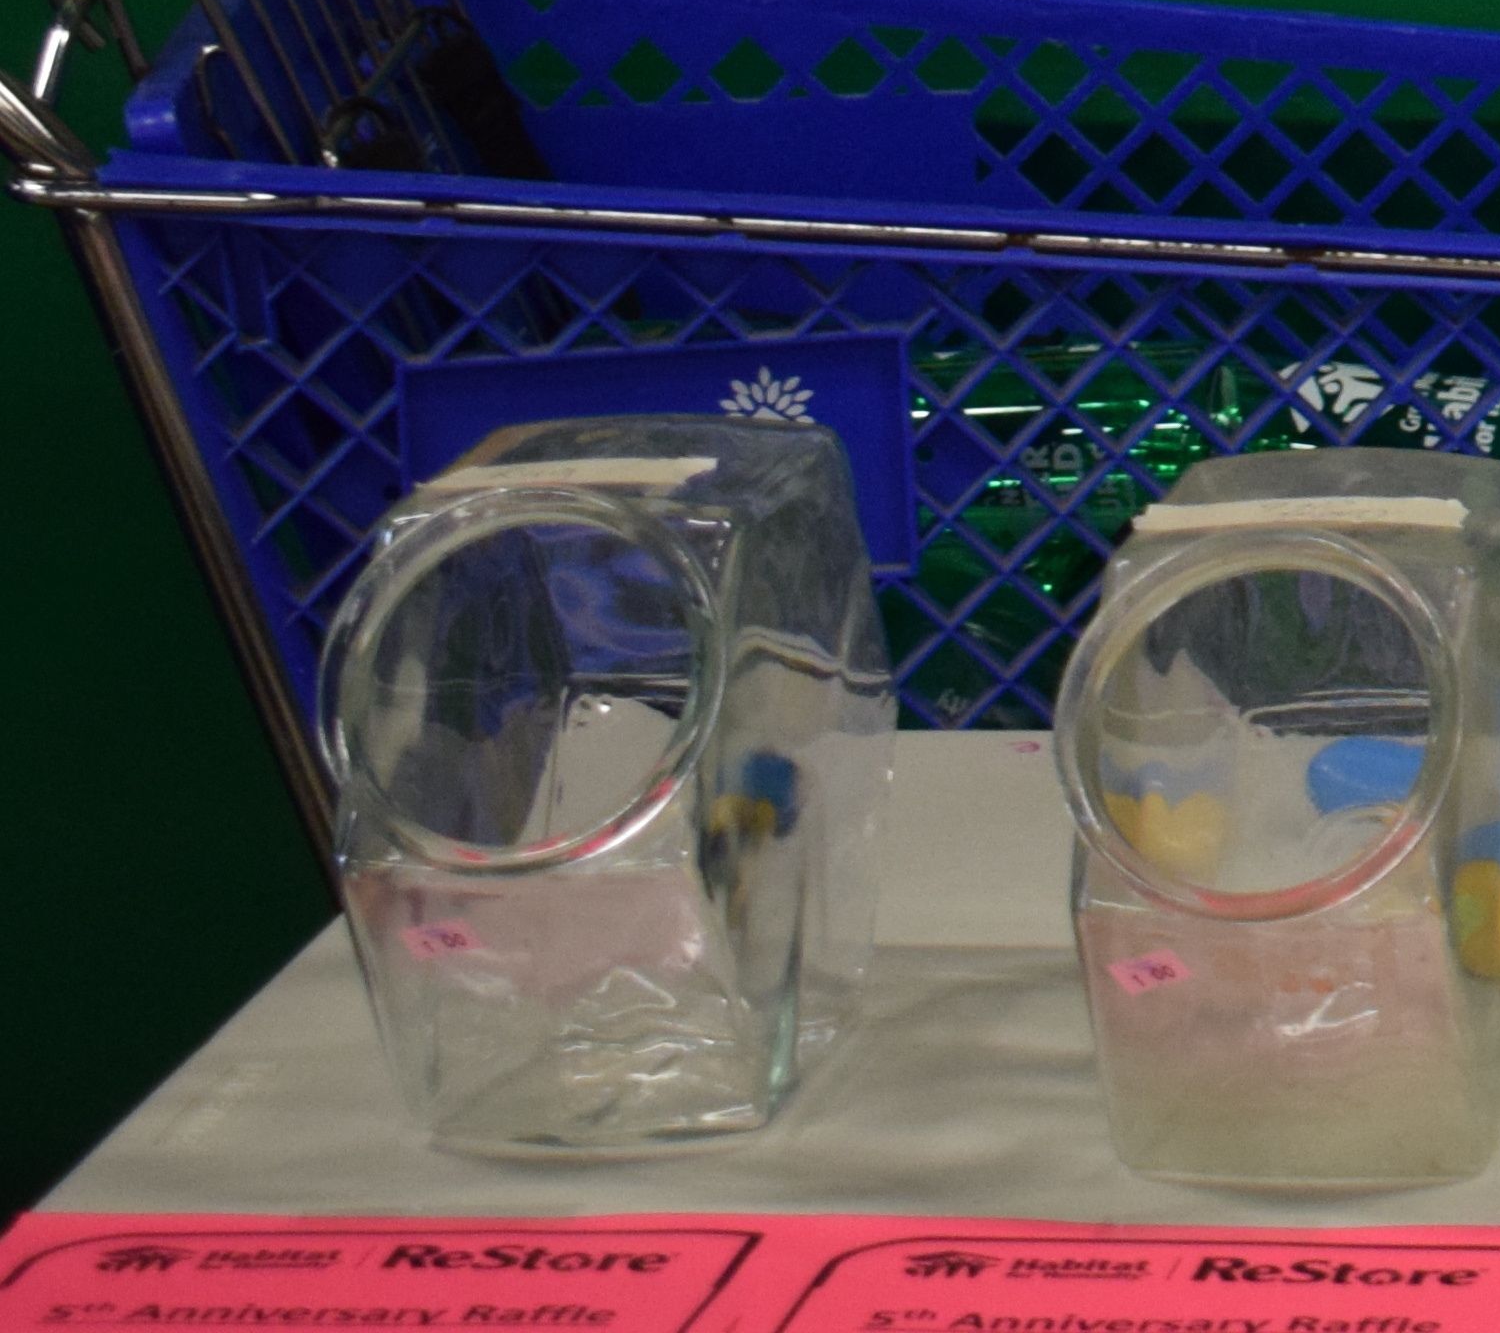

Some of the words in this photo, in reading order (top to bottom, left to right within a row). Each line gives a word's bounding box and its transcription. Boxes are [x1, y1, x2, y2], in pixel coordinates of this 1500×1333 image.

[380, 1244, 672, 1273] ReStore
[1191, 1257, 1481, 1287] ReStore
[126, 1302, 445, 1326] Anniversary
[459, 1303, 618, 1322] Raffle
[950, 1311, 1272, 1333] Anniversary
[1285, 1315, 1442, 1333] Raffle
